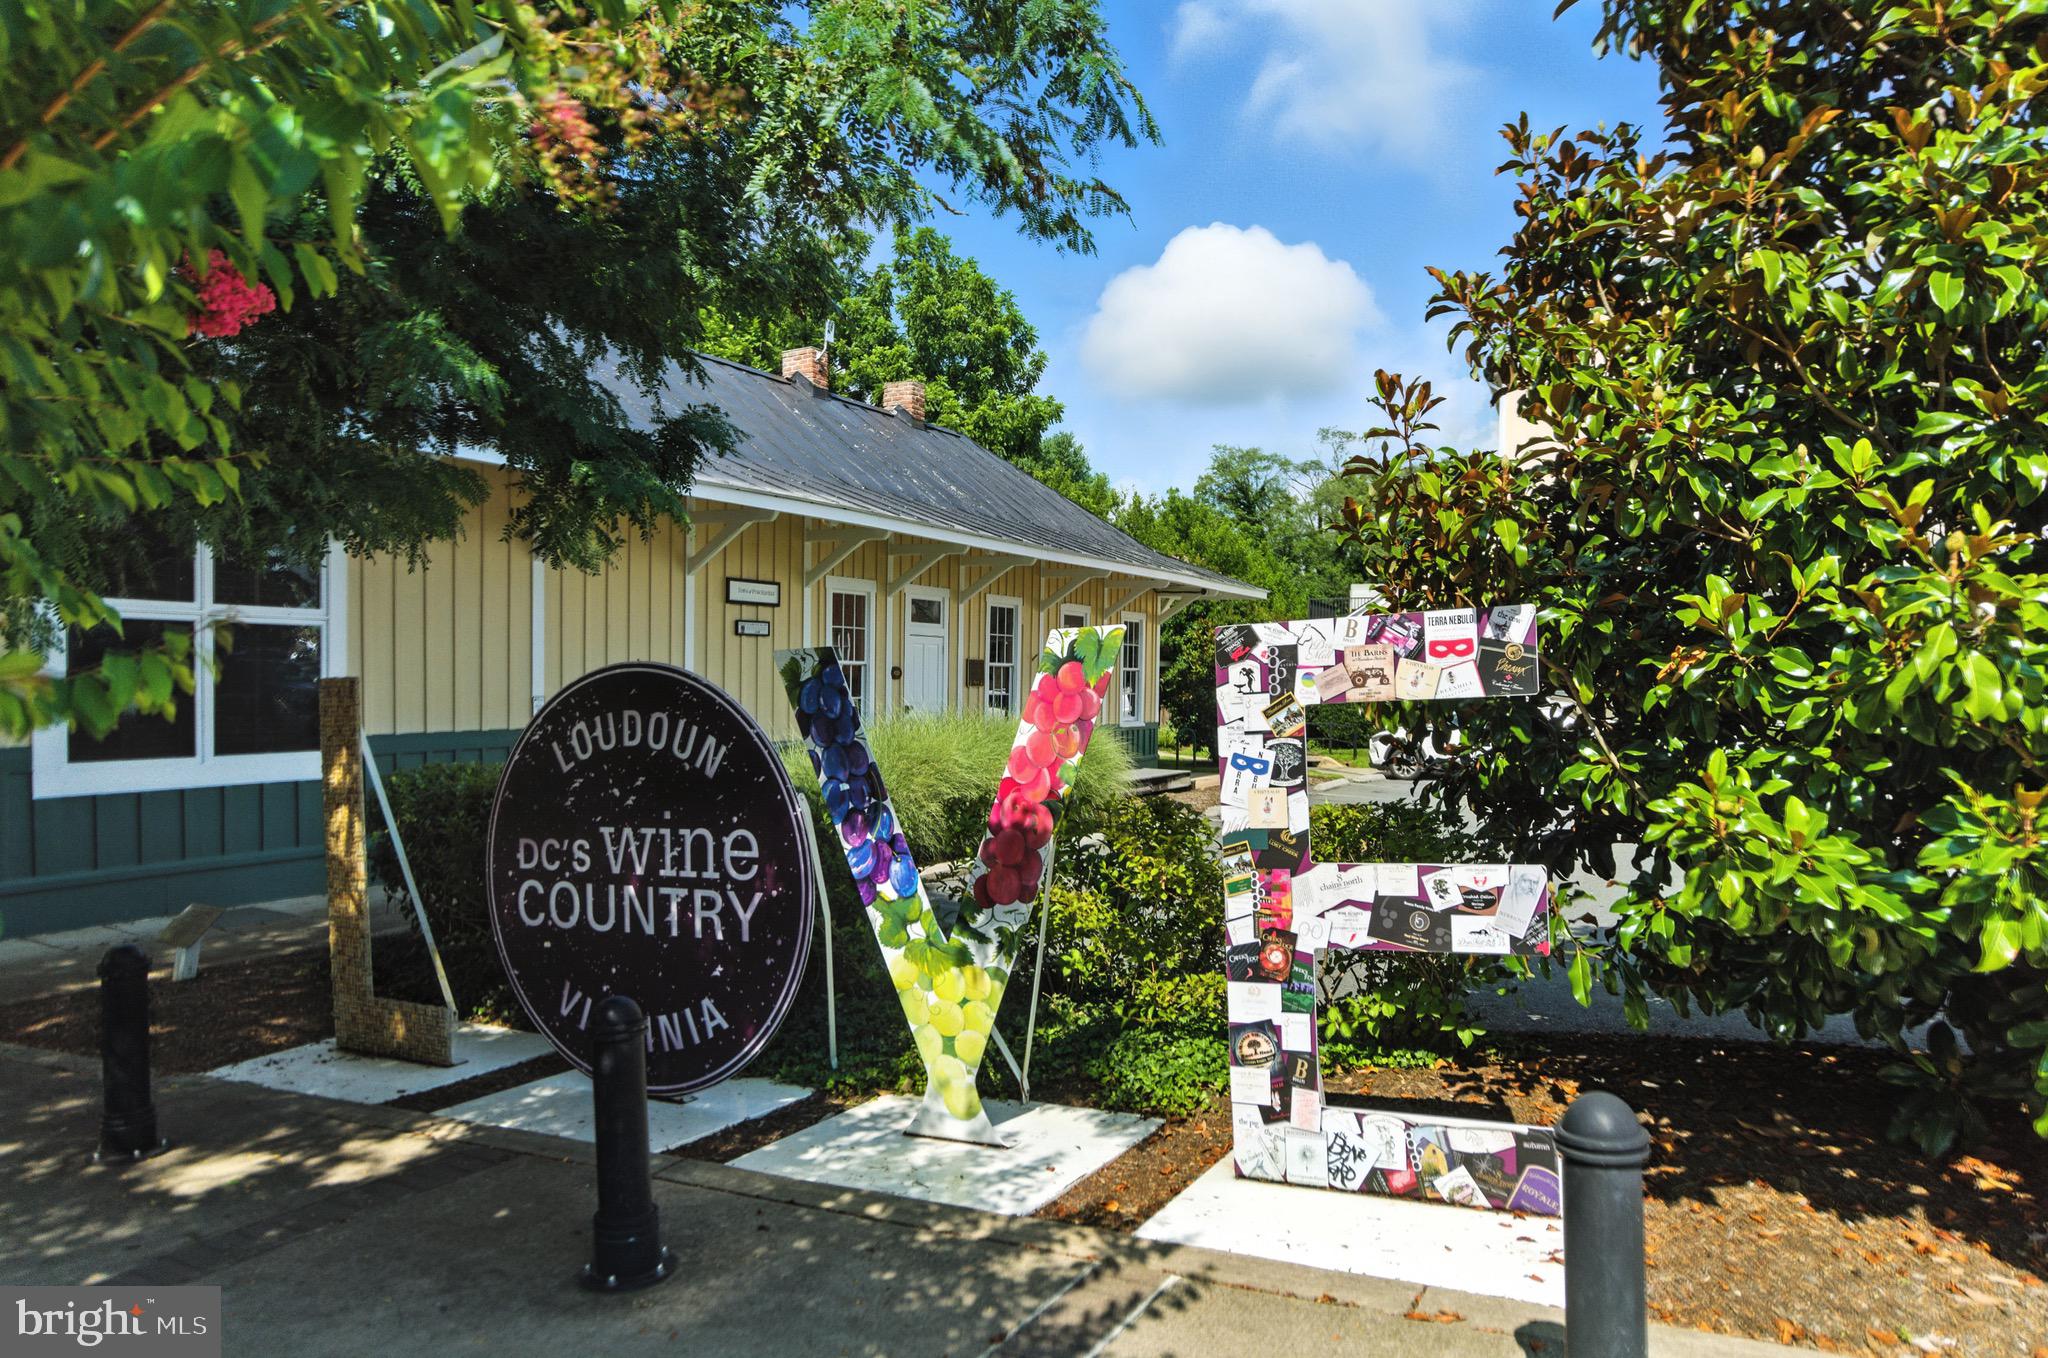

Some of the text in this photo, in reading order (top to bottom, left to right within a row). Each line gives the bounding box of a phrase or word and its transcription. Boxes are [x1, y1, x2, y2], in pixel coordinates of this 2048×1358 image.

[1428, 614, 1474, 627] TERRA NEBULO
[1225, 636, 1245, 652] TENACITY
[1364, 649, 1388, 657] BARNS
[552, 710, 727, 779] LOUDOUN
[517, 838, 591, 873] DC'S
[1320, 880, 1342, 892] chains
[1343, 875, 1363, 887] north
[518, 880, 762, 943] COUNTRY
[560, 980, 729, 1053] VIINIA
[1296, 1057, 1308, 1079] B
[1521, 1183, 1560, 1210] ROYALE
